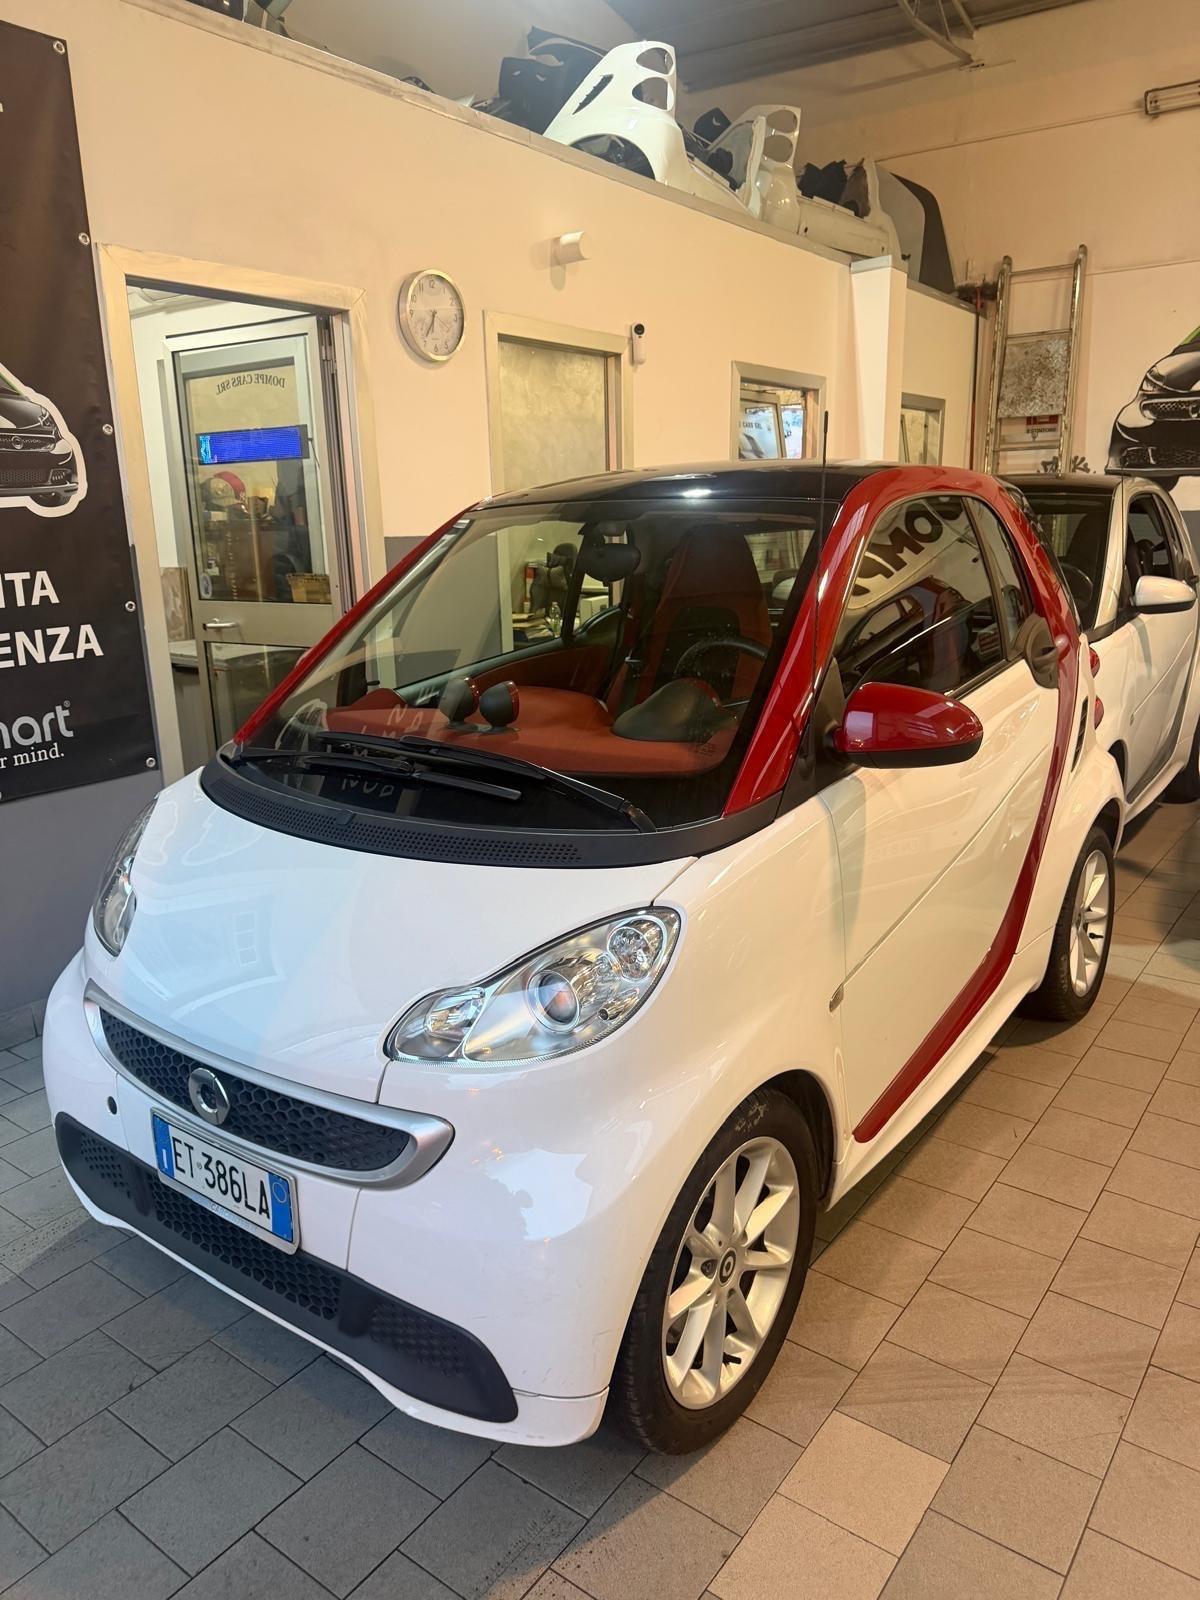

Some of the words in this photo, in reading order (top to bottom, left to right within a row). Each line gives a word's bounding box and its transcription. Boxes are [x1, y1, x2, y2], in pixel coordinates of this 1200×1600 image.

[13, 742, 65, 767] mind.
[172, 1136, 194, 1179] ET
[201, 1151, 271, 1220] 386LA
